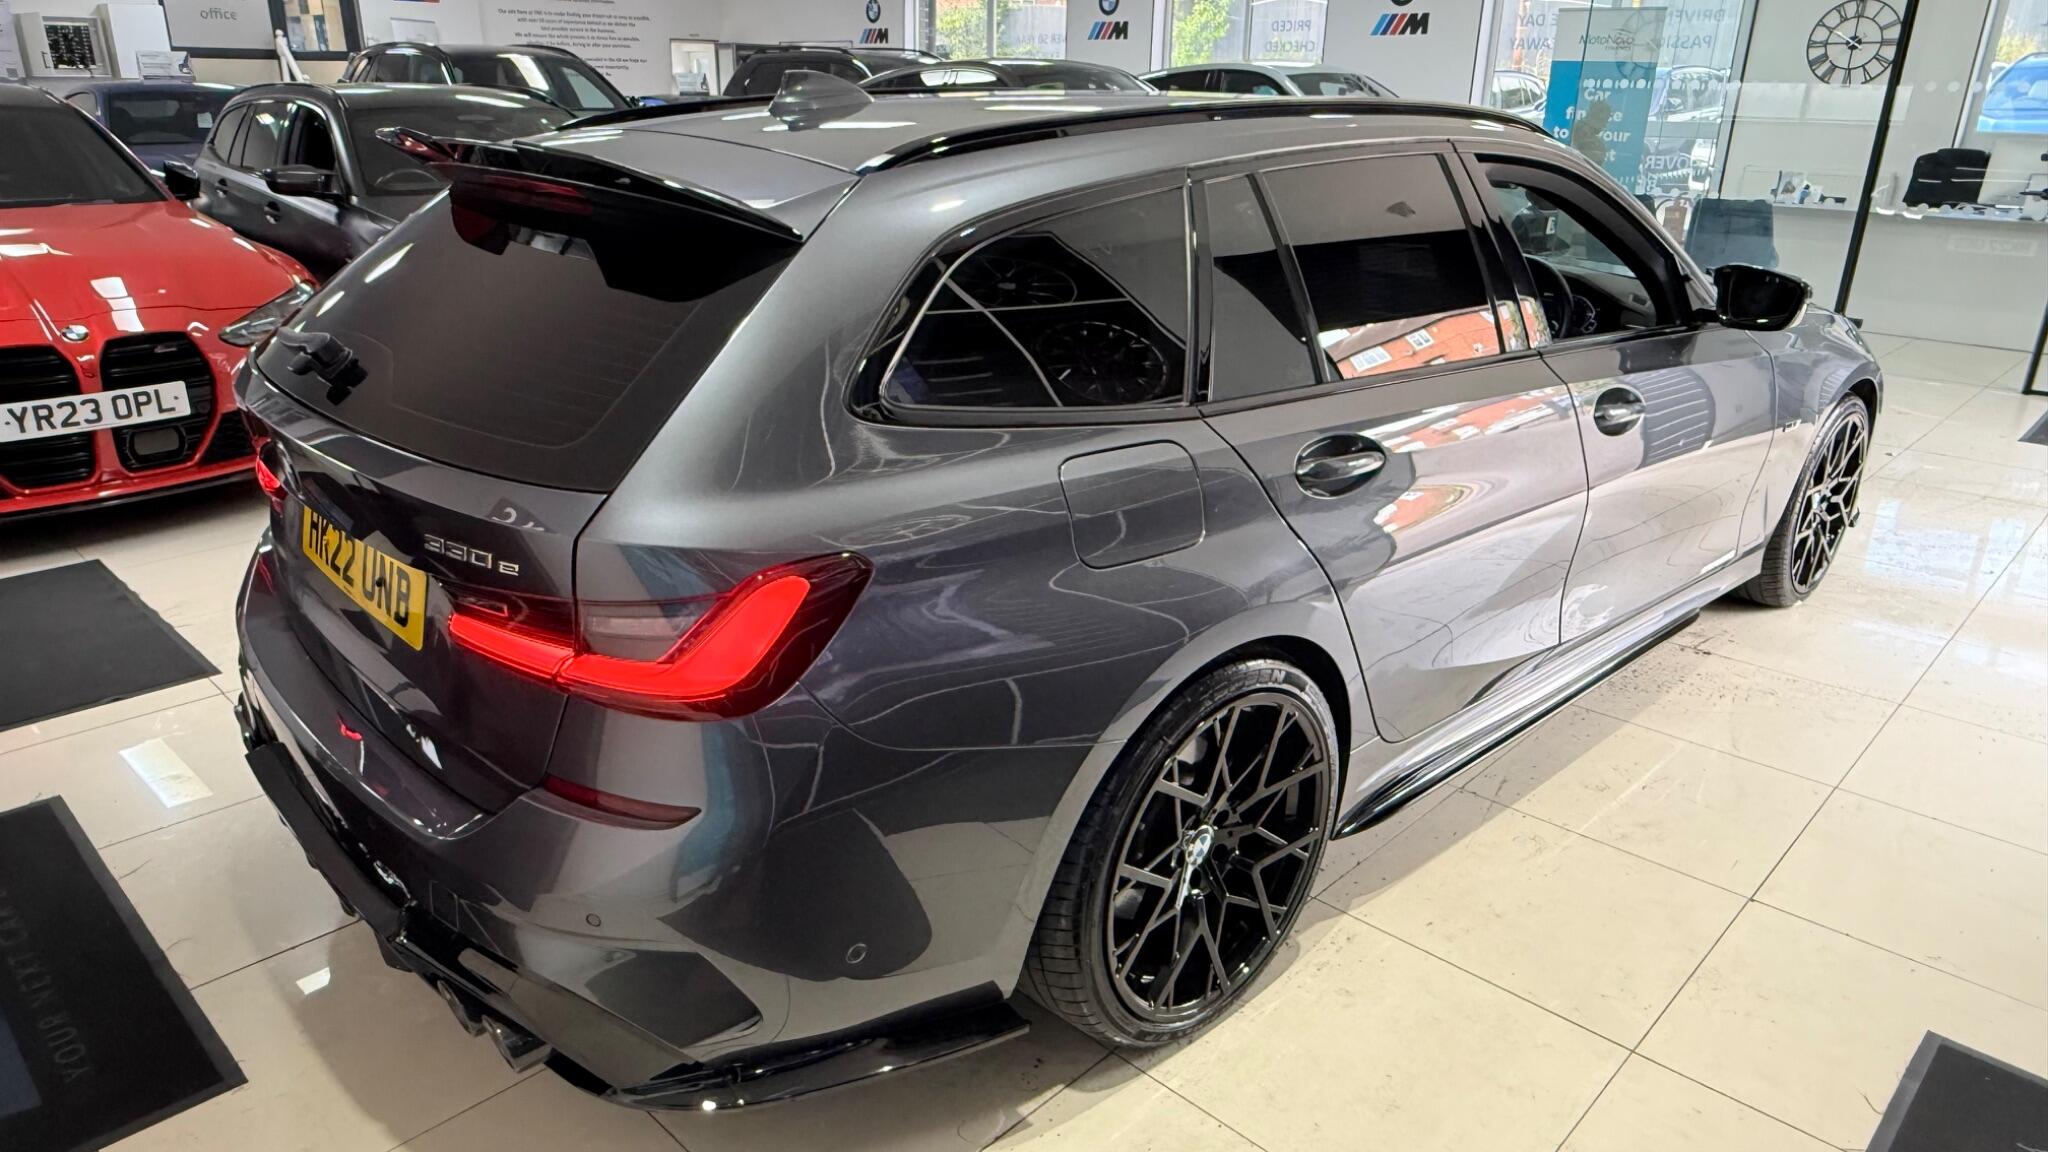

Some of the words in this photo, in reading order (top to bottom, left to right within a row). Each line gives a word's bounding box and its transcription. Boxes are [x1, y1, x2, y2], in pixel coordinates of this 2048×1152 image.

[199, 7, 238, 21] office
[1554, 126, 1570, 139] to
[7, 398, 103, 434] YR23
[111, 389, 176, 421] OPL
[424, 533, 493, 569] 330
[498, 561, 519, 577] e
[362, 542, 412, 628] UNB
